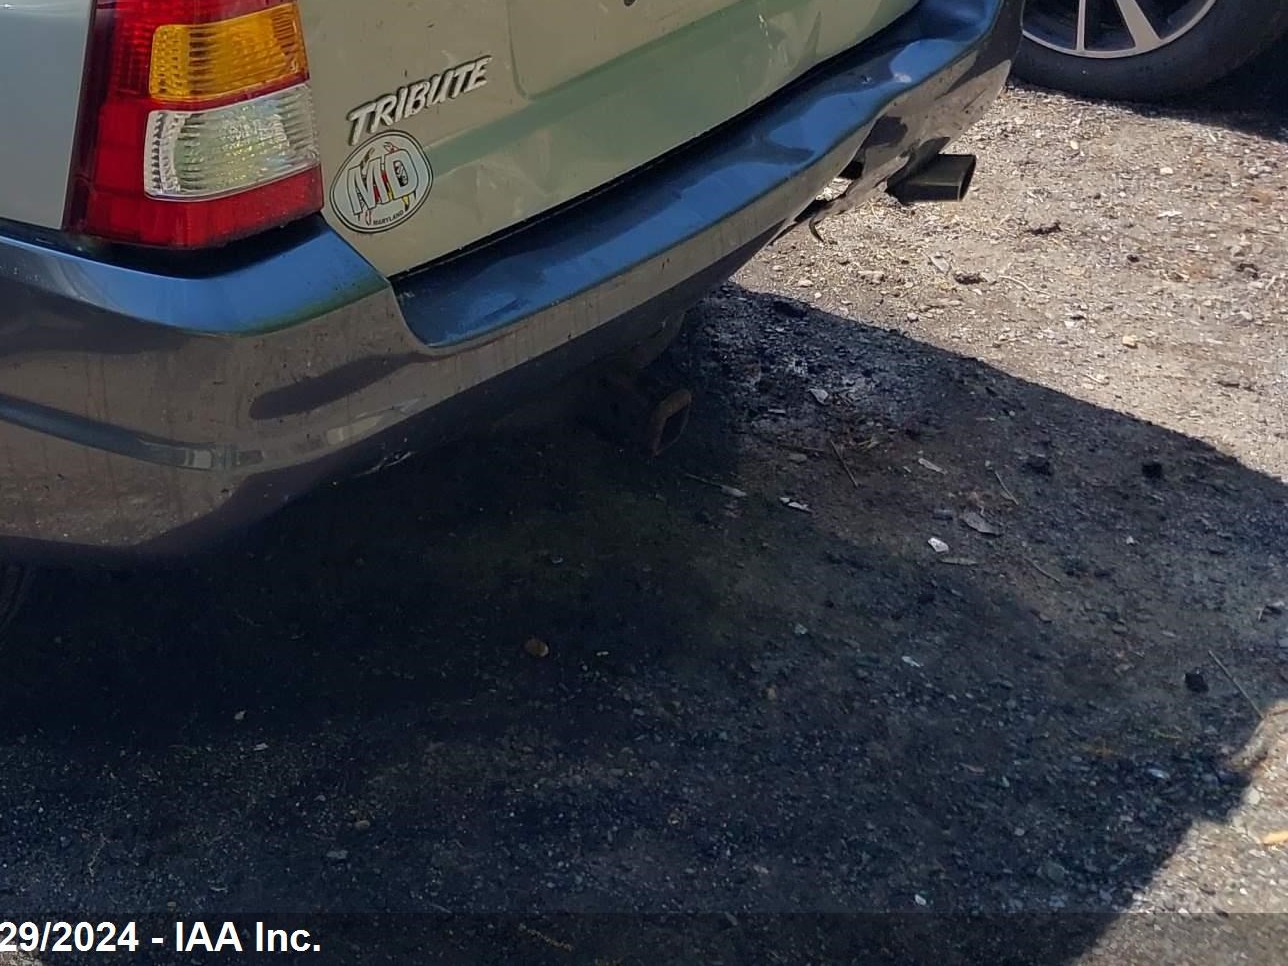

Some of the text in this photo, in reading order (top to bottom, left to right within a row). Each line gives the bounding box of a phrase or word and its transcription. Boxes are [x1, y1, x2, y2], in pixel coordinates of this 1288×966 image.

[346, 54, 492, 146] TRIBUTE
[346, 148, 419, 216] MD
[372, 209, 405, 226] MARYLAND
